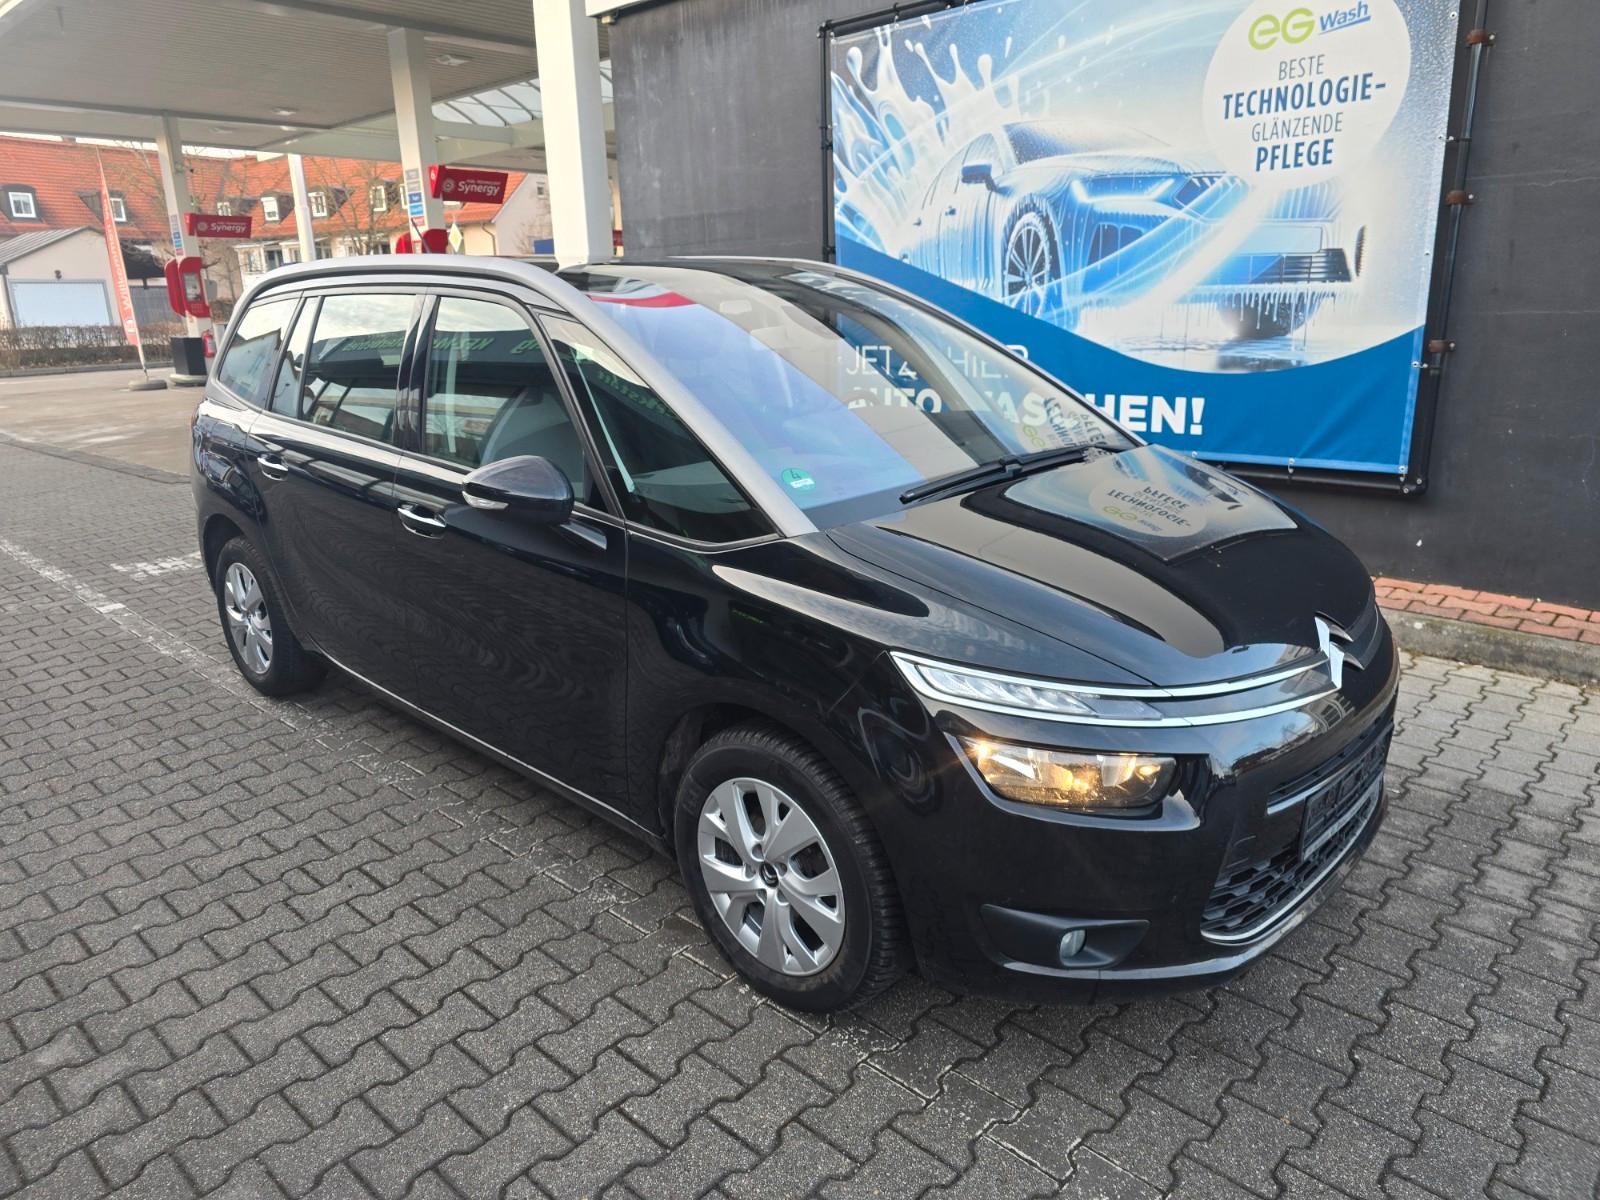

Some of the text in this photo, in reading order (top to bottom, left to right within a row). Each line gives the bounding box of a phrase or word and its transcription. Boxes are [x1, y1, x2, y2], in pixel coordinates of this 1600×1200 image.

[1319, 1, 1369, 32] Wash
[1278, 54, 1326, 81] BESTE
[1223, 72, 1386, 120] TECHNOLOGIE-
[1251, 112, 1344, 142] GLÄNZENDE
[1255, 138, 1334, 172] PFLEGE
[457, 180, 500, 197] Synergy
[210, 222, 247, 234] Synergy
